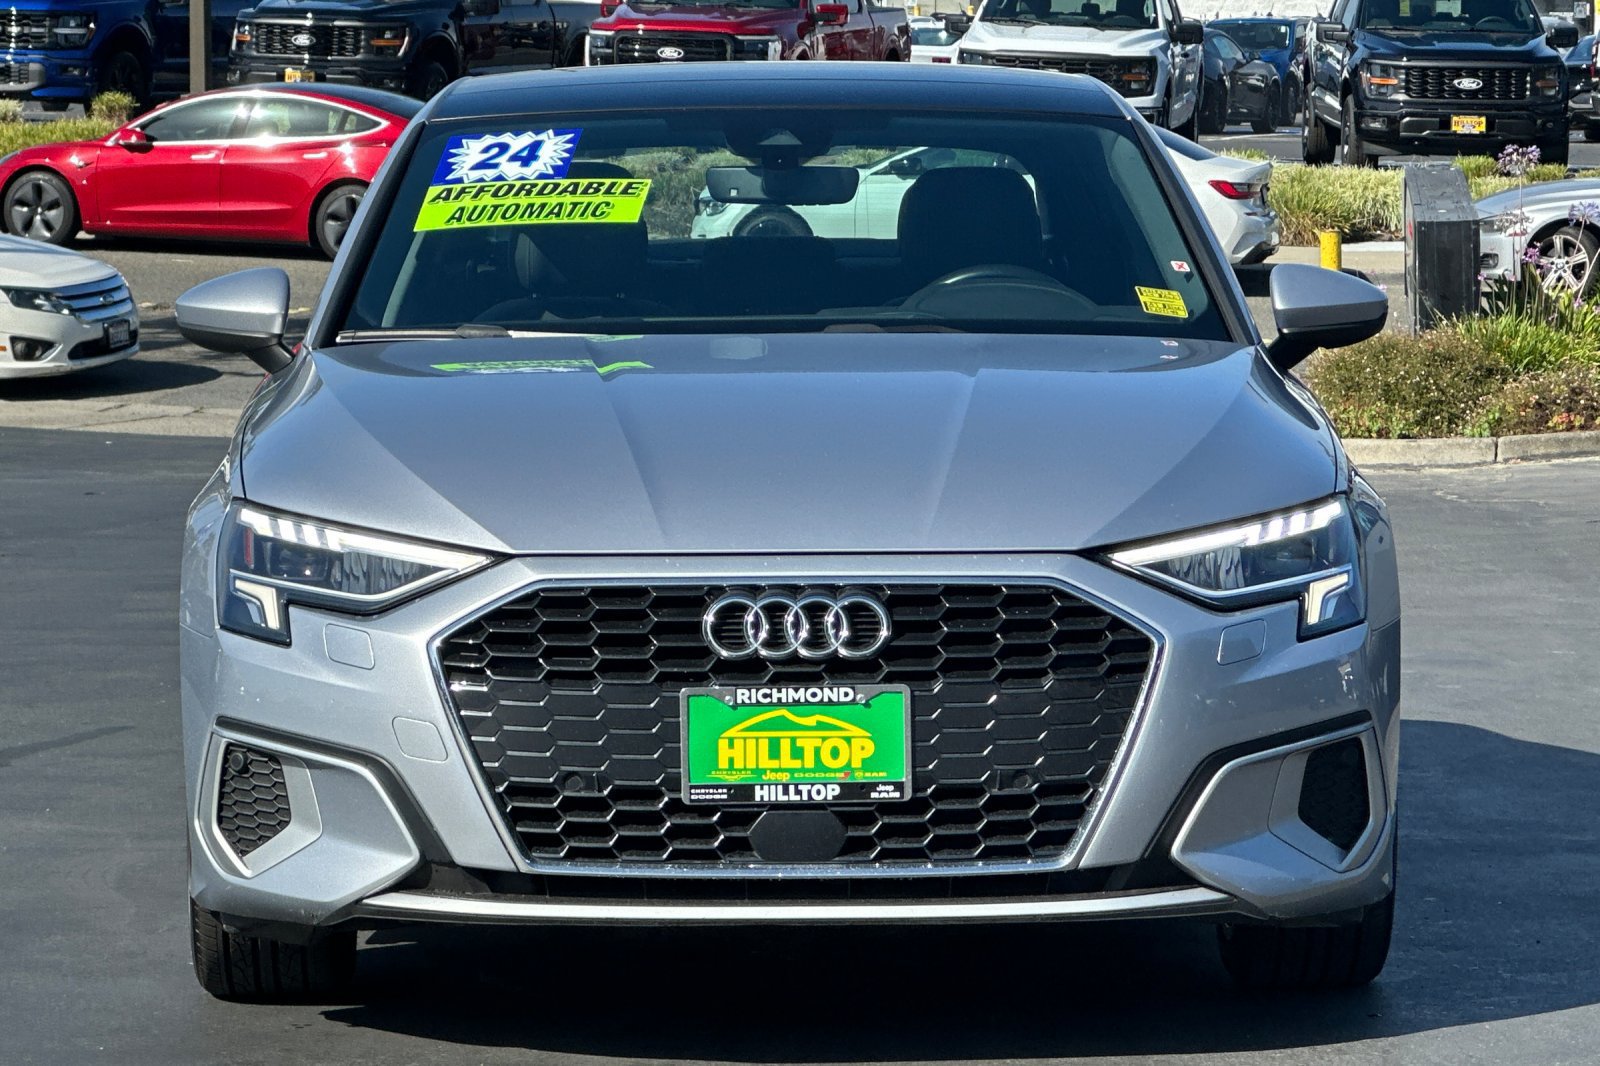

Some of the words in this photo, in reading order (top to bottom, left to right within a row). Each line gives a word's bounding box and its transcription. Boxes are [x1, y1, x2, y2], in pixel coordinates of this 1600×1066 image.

[468, 139, 547, 172] 24
[428, 181, 647, 205] AFFORDABLE
[445, 201, 615, 225] AUTOMATIC
[736, 687, 855, 704] RICHMOND
[717, 737, 876, 769] HILLTOP
[762, 770, 790, 782] Jeep
[754, 784, 841, 801] HILLTOP
